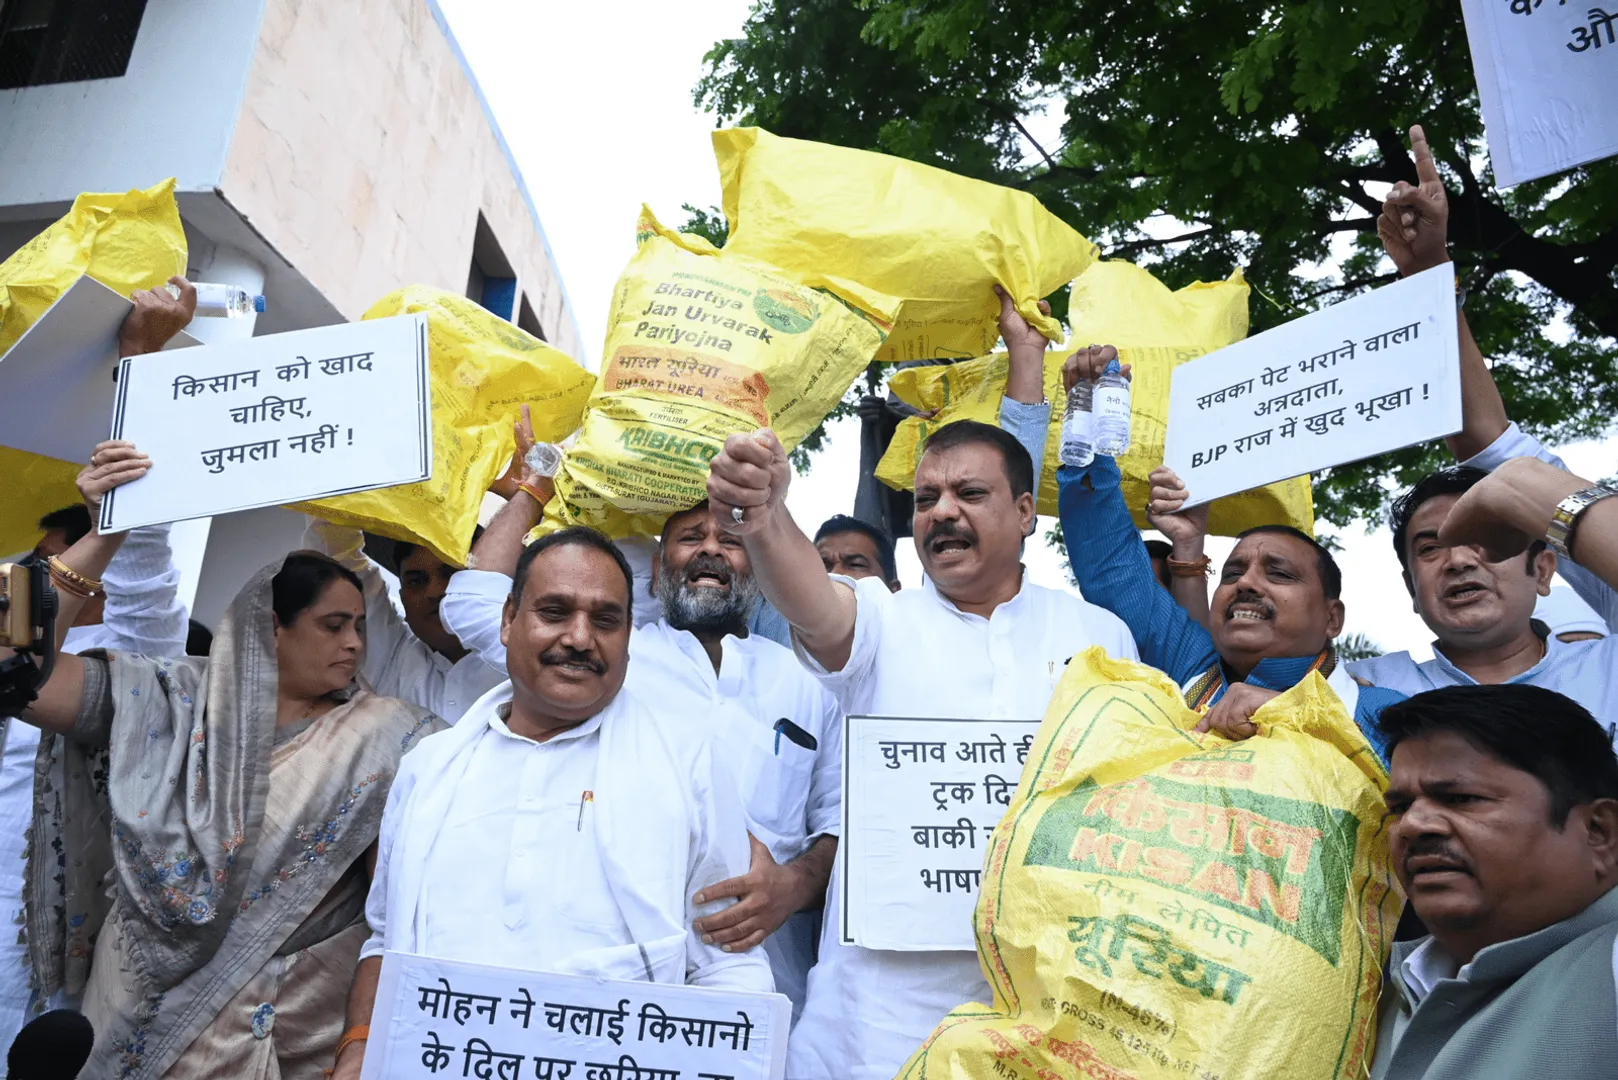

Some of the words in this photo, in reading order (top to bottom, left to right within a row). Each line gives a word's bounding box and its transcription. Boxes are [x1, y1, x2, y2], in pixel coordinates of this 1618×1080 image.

[1566, 8, 1618, 52] औ
[654, 282, 744, 311] Bhartiya
[633, 321, 733, 352] Pariyojna
[642, 300, 678, 317] Jan
[684, 305, 774, 345] Urvarak
[171, 369, 261, 401] किसान
[275, 356, 312, 383] को
[318, 351, 375, 376] खाद
[618, 355, 662, 370] भारत
[666, 356, 723, 380] यूरिया
[1196, 378, 1255, 411] सबका
[1260, 365, 1292, 387] पेट
[1298, 340, 1358, 374] भराने
[1363, 321, 1421, 353] वाला
[616, 377, 664, 391] BHARAT
[667, 381, 704, 399] UREA
[1253, 378, 1344, 417] अन्नदाता,
[229, 395, 312, 425] चाहिए,
[649, 412, 689, 426] FERTILISER
[1191, 444, 1228, 469] BJP
[1233, 428, 1274, 454] राज
[1278, 416, 1299, 438] में
[1304, 406, 1347, 435] खुद
[1354, 386, 1413, 422] भूखा
[1422, 382, 1430, 400] !
[200, 438, 280, 474] जुमला
[287, 424, 340, 454] नहीं
[346, 428, 354, 446] !
[616, 426, 721, 461] KRIBHCO
[575, 457, 605, 473] KRISHAK
[606, 466, 642, 482] BHARATI
[644, 477, 708, 498] COOPERATIVE
[617, 461, 657, 476] MANUFACTURED
[662, 473, 691, 484] MARKETED
[651, 488, 678, 501] NAGAR,
[879, 741, 947, 769] चुनाव
[955, 733, 1007, 764] आते
[930, 782, 976, 811] ट्रक
[982, 774, 1019, 807] दि
[911, 817, 977, 849] बाकी
[1083, 777, 1323, 875] किसान
[1068, 827, 1301, 923] KISAN
[1083, 878, 1139, 905] नीम
[1156, 900, 1254, 949] लेपित
[1067, 914, 1254, 1007] यूरिया
[417, 977, 502, 1027] मोहन
[509, 988, 537, 1029] ने
[544, 999, 630, 1047] चलाई
[638, 1002, 754, 1051] किसानो
[421, 1031, 456, 1074] के
[463, 1037, 525, 1080] दिल
[533, 1056, 577, 1080] पर
[1060, 1001, 1106, 1031] GROSS
[1174, 1058, 1200, 1075] NET
